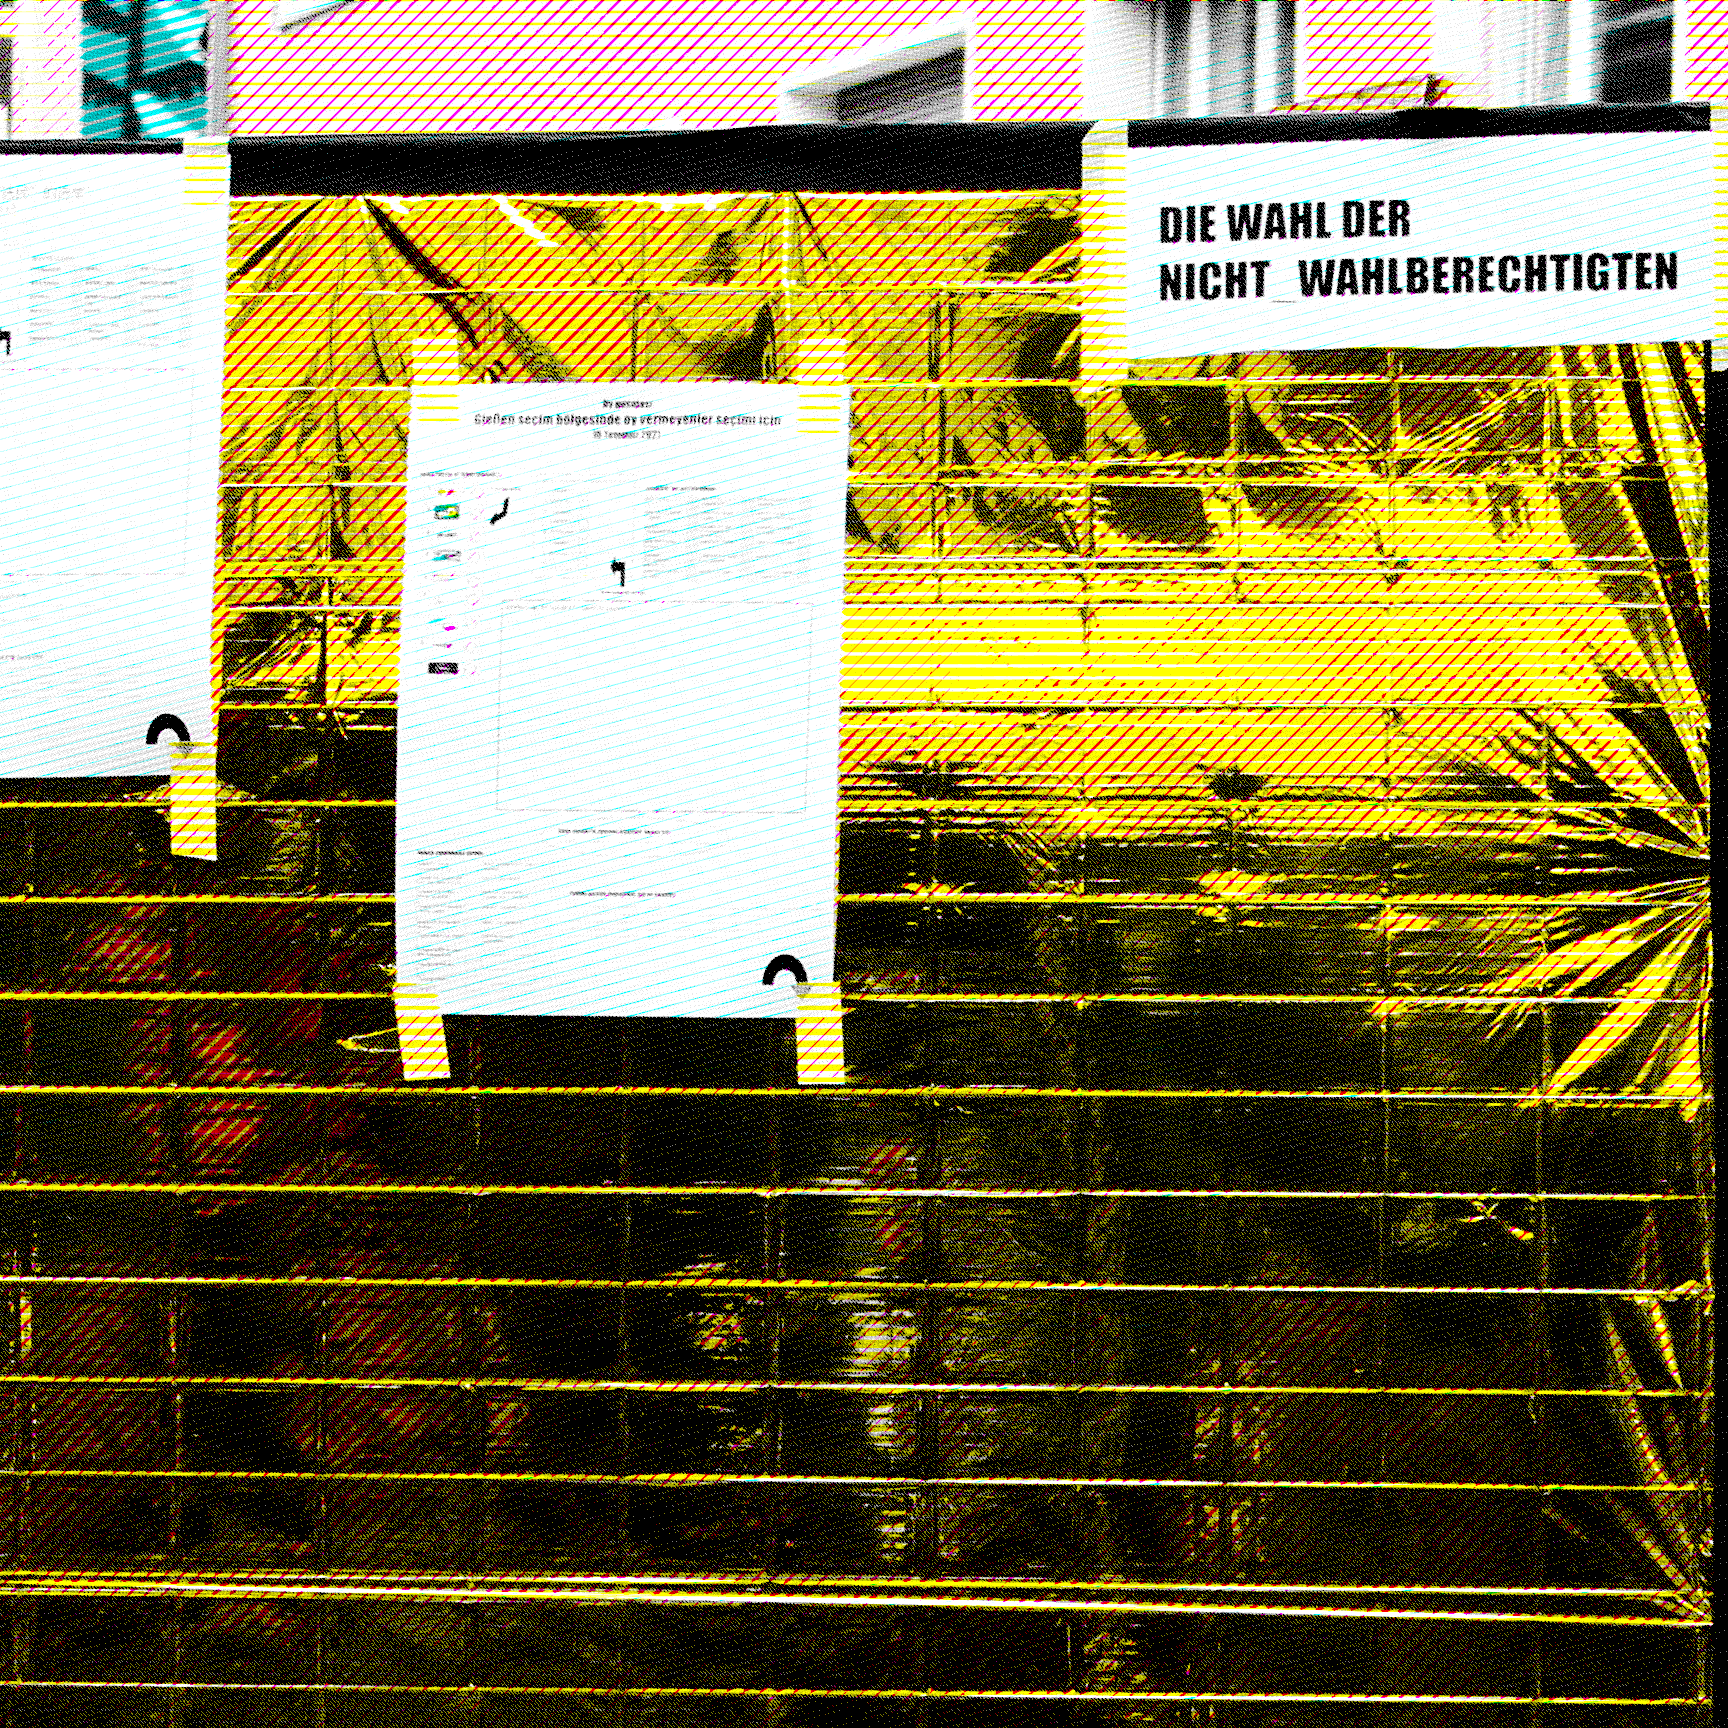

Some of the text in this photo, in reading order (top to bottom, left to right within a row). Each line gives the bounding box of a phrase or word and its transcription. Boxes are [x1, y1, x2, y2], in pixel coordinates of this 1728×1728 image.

[1160, 199, 1410, 243] DIE WAHL DER
[1160, 252, 1678, 301] NICHT WAHLBERECHTIGTEN
